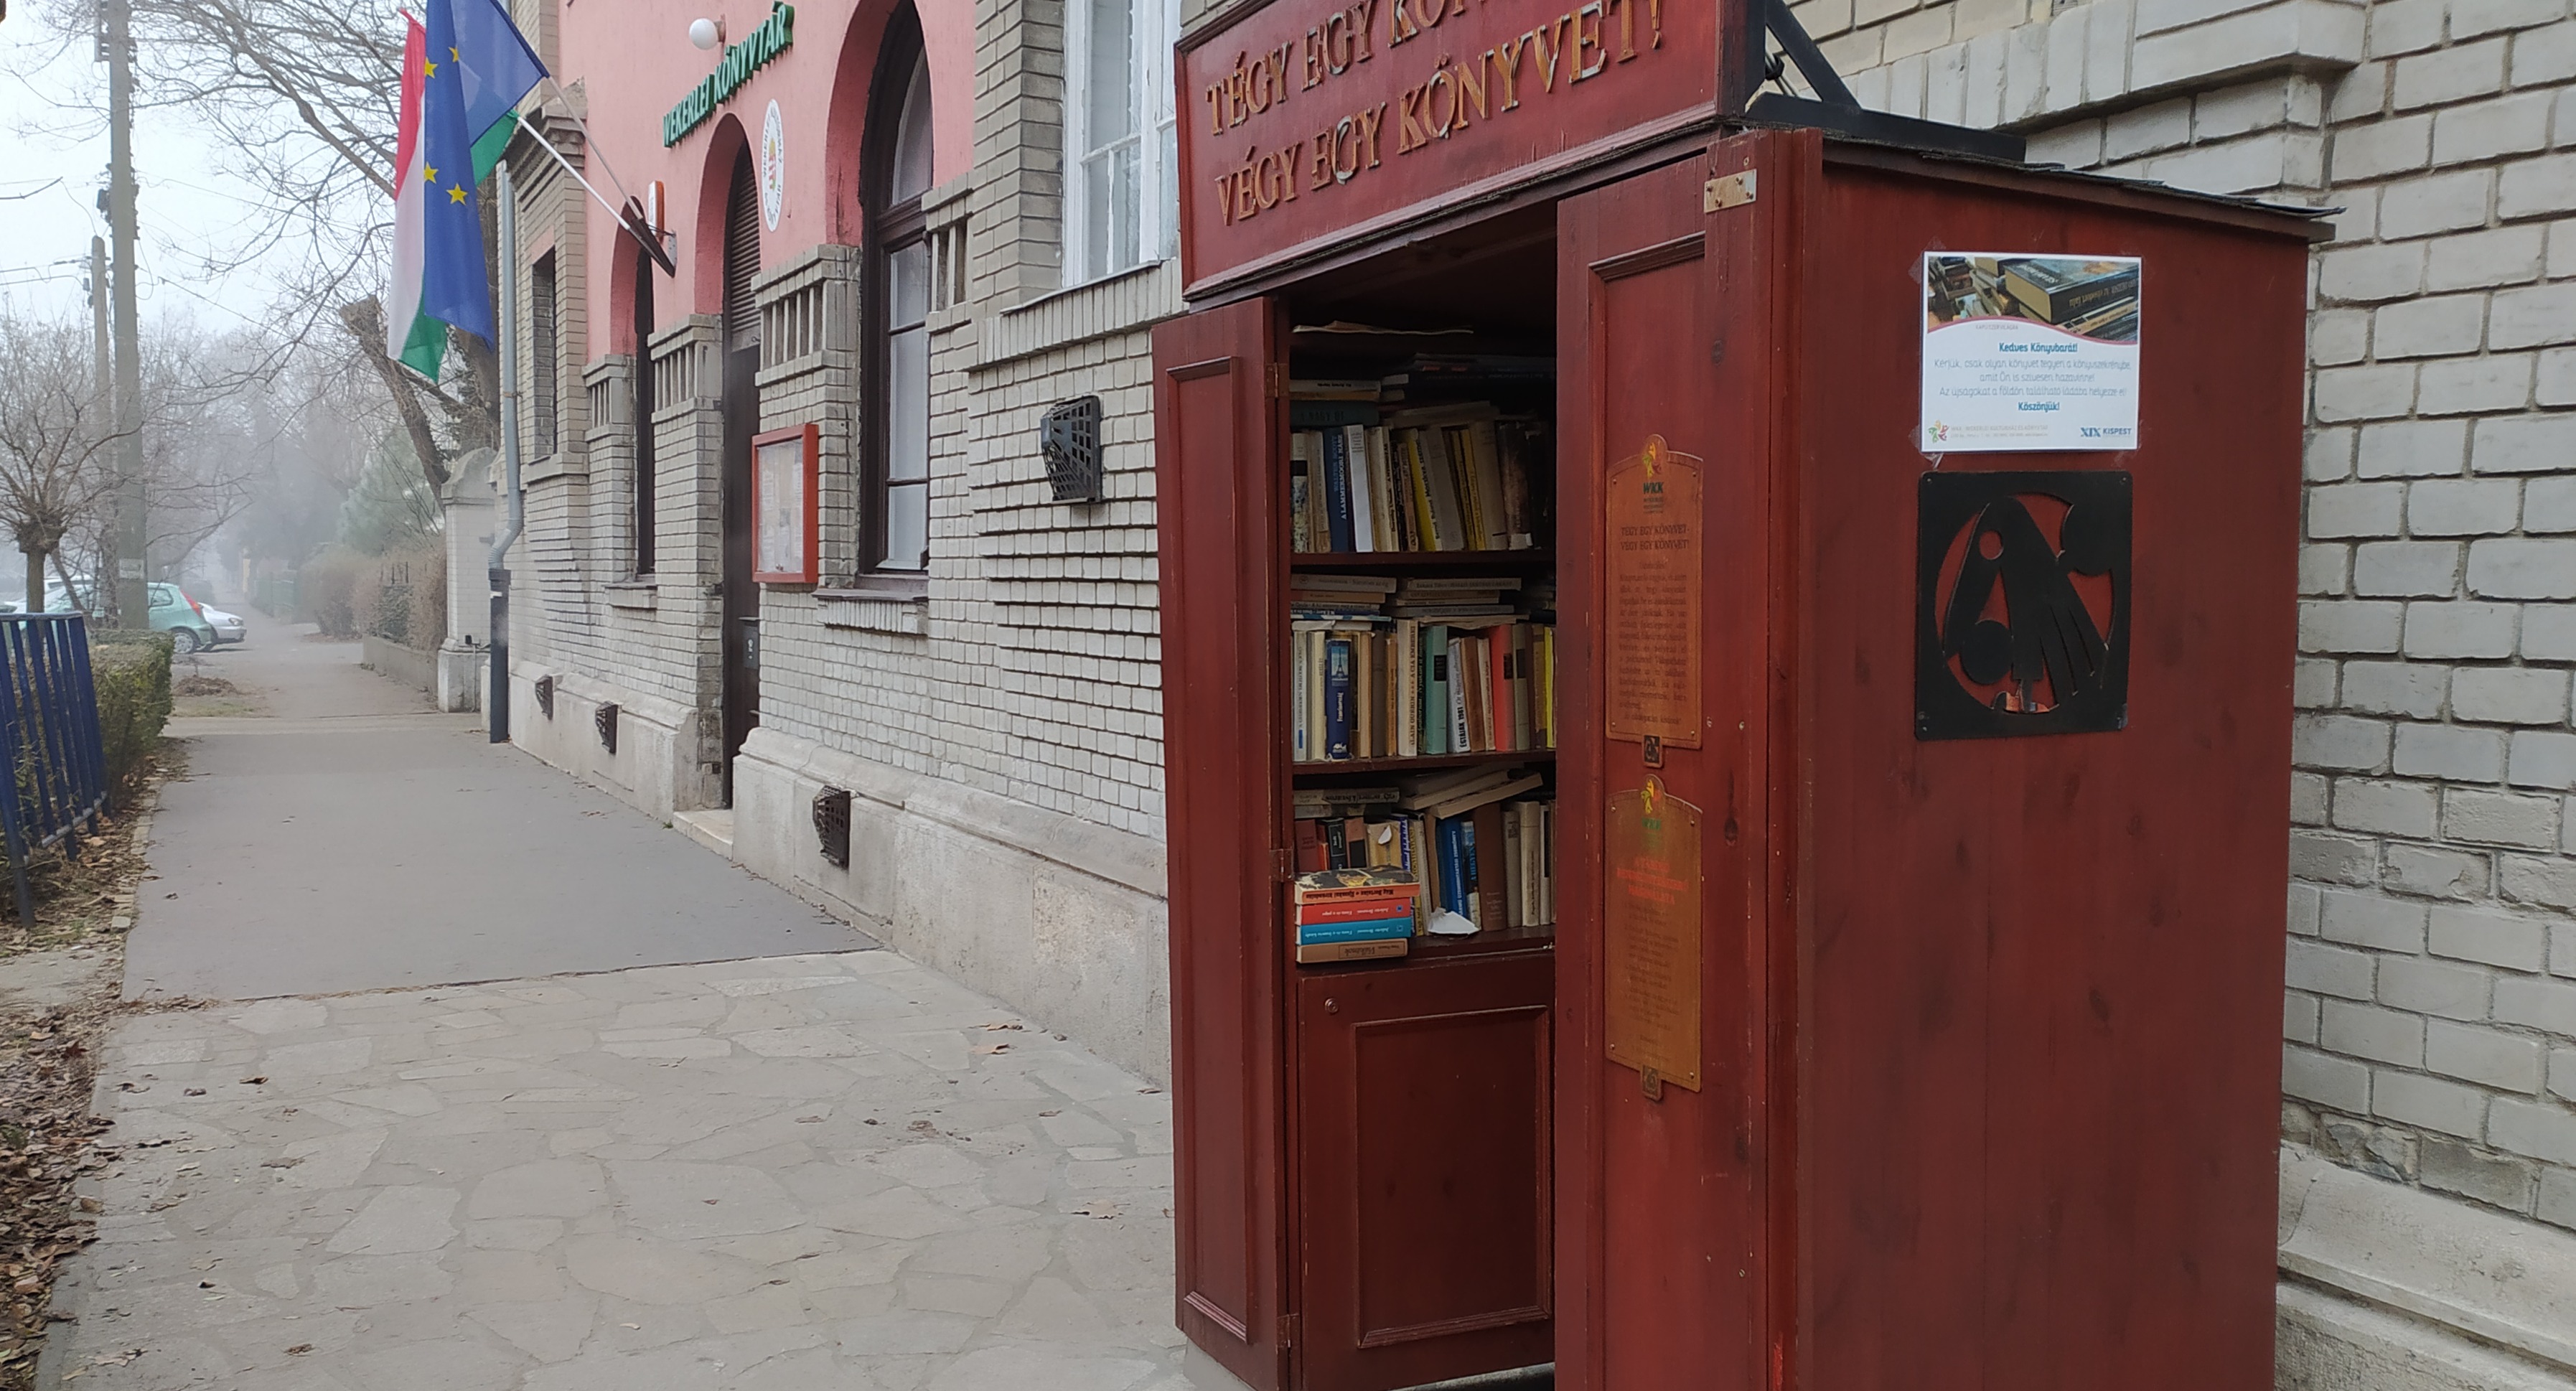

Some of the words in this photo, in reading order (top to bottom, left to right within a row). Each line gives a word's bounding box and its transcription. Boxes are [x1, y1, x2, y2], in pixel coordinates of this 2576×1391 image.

[663, 74, 715, 148] WEKERLEI
[713, 1, 794, 105] KÖNYVTÁR
[1205, 40, 1292, 136] TÉGY
[1301, 0, 1373, 92] EGY
[1214, 146, 1302, 226] VÉGY
[1310, 101, 1387, 192] EGY
[1396, 0, 1663, 154] KÖNYVET!
[1999, 343, 2028, 352] Kedves
[2030, 342, 2078, 355] Könyvbarát!
[1934, 359, 1962, 369] Kérjük,
[1964, 360, 1983, 368] csak
[1985, 360, 2007, 370] olyan
[2008, 360, 2039, 370] könyvet
[2041, 360, 2064, 370] tegyen
[2000, 372, 2011, 382] Ön
[1952, 388, 1990, 398] újságokat
[1999, 387, 2024, 395] földön
[2018, 402, 2059, 412] Köszönjük!
[2081, 428, 2102, 437] XIX
[1336, 455, 1346, 513] LAMMERMOORI
[1642, 482, 1664, 495] WKK
[1455, 706, 1465, 720] 1981
[1456, 721, 1467, 748] ÉGTÁJAK
